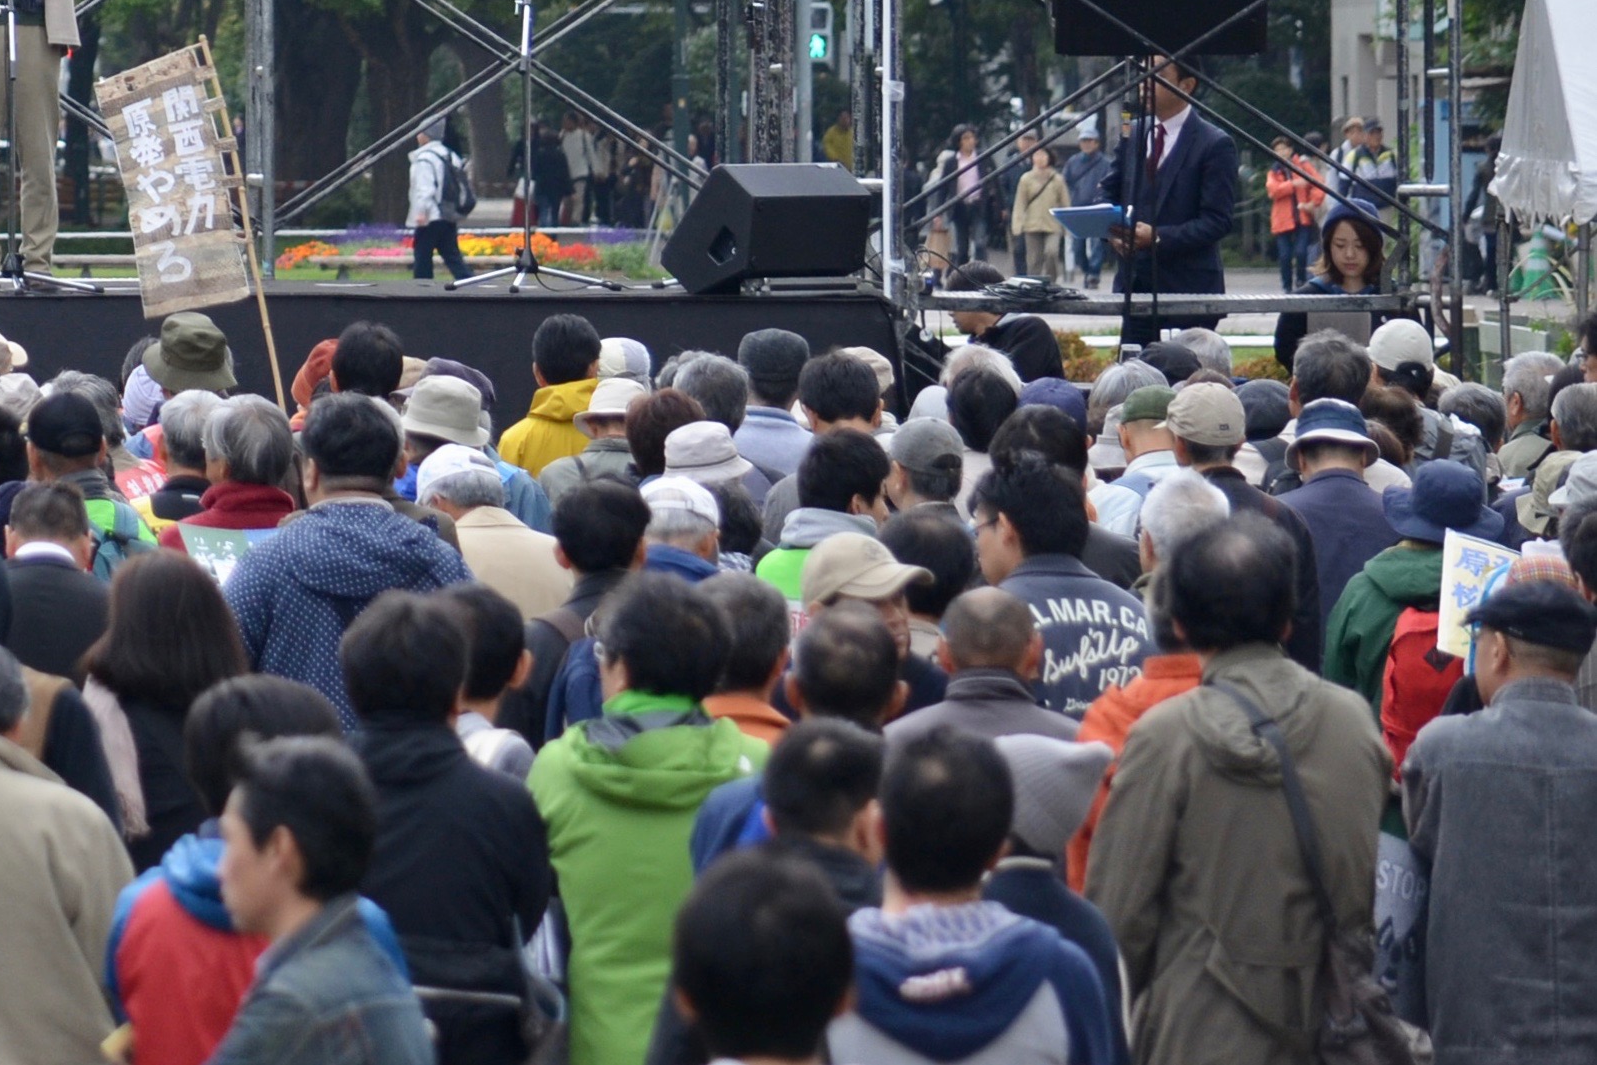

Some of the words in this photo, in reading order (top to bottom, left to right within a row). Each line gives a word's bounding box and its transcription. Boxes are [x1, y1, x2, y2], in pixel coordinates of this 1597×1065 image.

[121, 97, 192, 284] 原発やめろ
[162, 85, 216, 236] 関西電力
